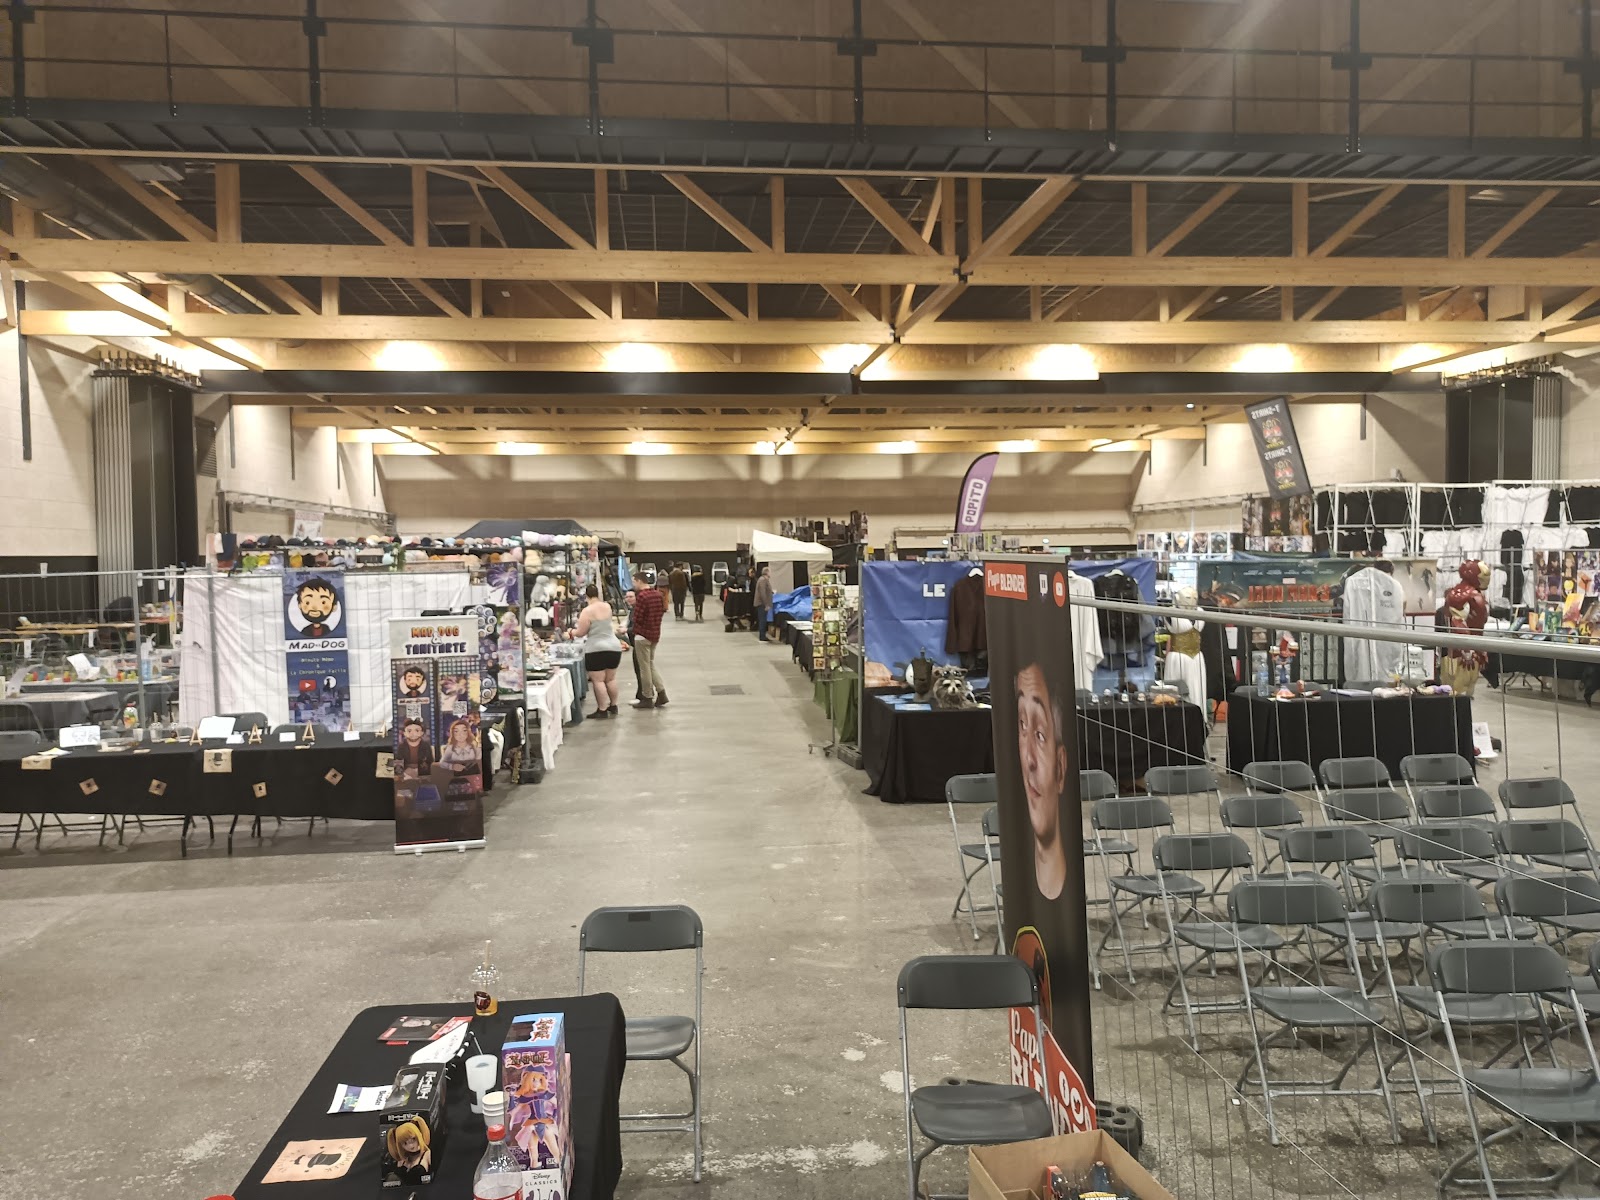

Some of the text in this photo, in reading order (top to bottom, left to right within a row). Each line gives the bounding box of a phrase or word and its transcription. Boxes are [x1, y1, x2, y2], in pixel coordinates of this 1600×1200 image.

[922, 583, 946, 598] LE
[1000, 573, 1026, 593] BLENDER
[1247, 585, 1283, 603] IRON
[1287, 585, 1318, 602] MAN
